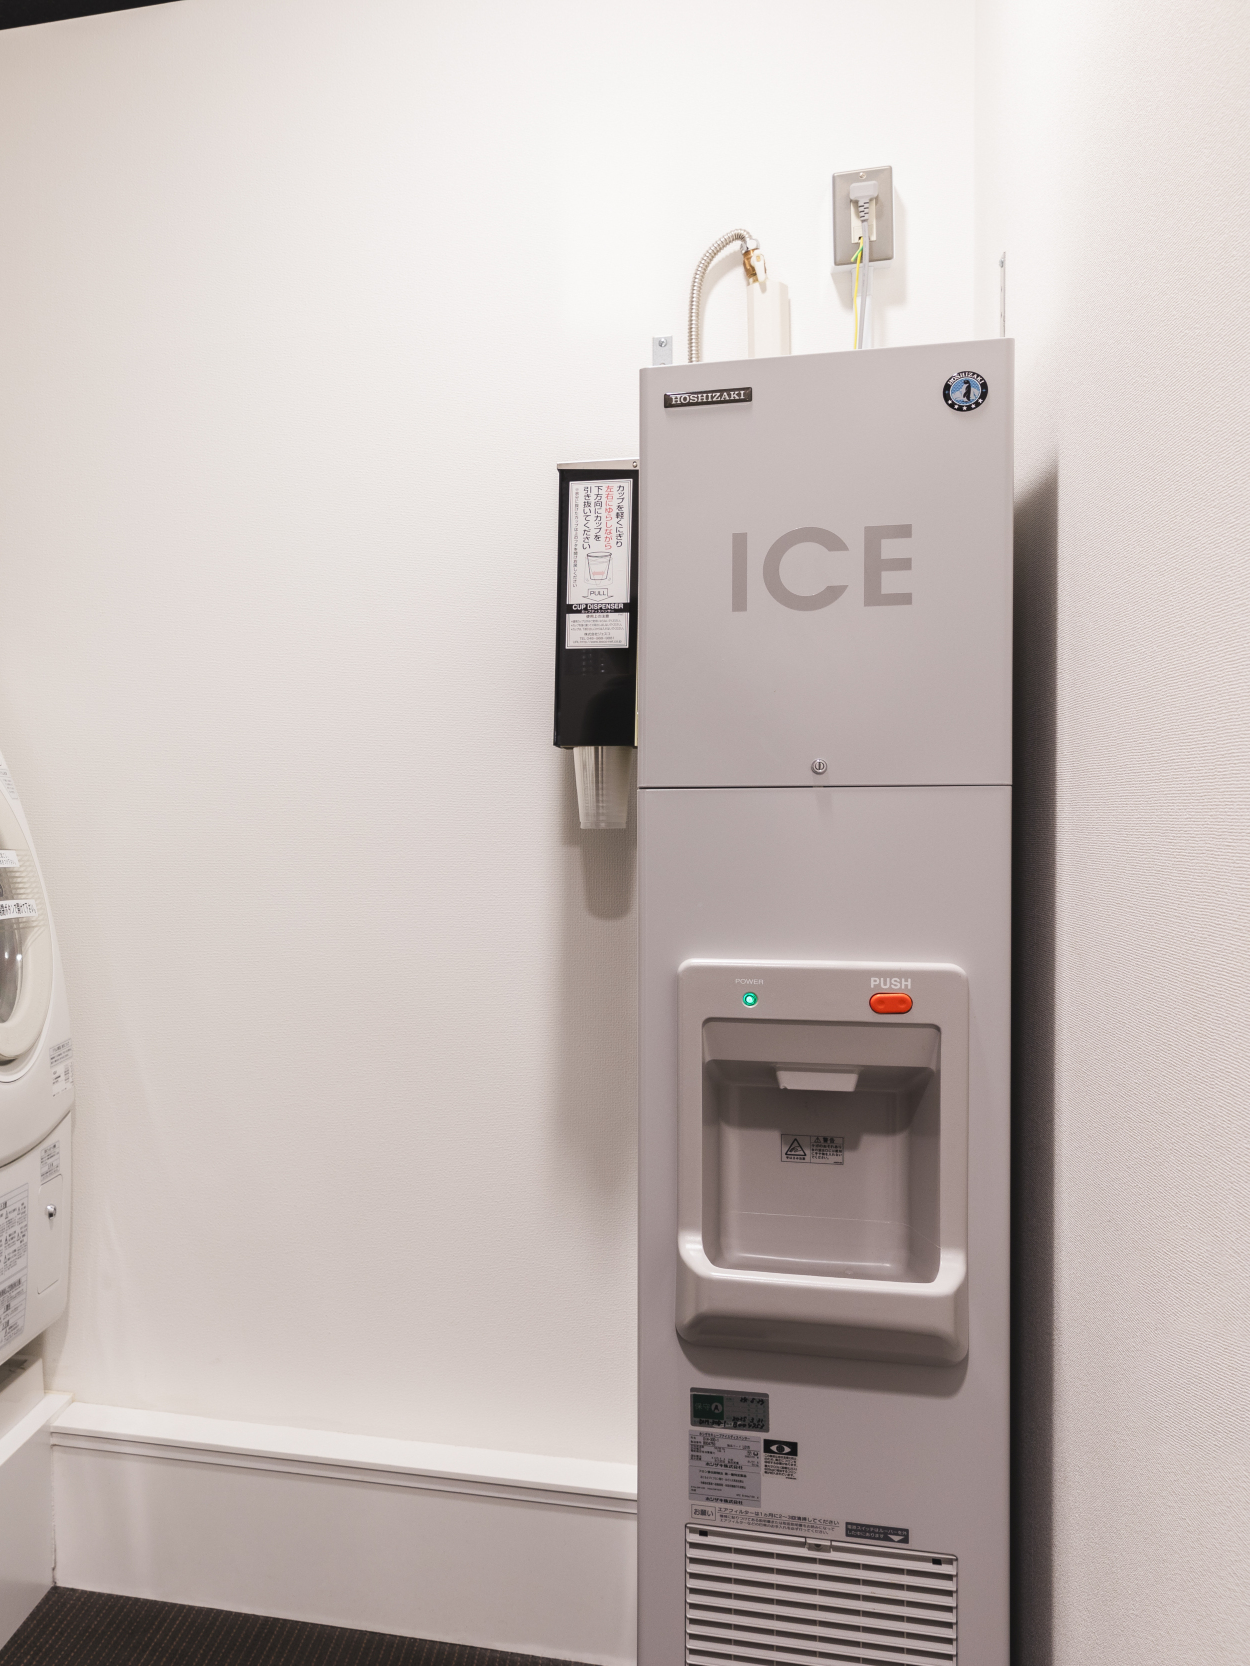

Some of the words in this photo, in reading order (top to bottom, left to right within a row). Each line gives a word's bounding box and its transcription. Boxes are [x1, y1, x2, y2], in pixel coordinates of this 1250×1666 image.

[947, 372, 985, 385] HOSHIZAKI
[671, 391, 745, 404] HOSHIZAKI
[582, 486, 592, 550] 引き抜いてください
[594, 486, 603, 541] 下方向にカップを
[604, 485, 614, 550] 左右にゆらしながら
[616, 485, 625, 548] カップを軽くにぎり
[732, 524, 912, 612] ICE
[870, 978, 912, 989] PUSH
[693, 1508, 714, 1517] お願い
[706, 1497, 743, 1505] ホシザキ株式会社
